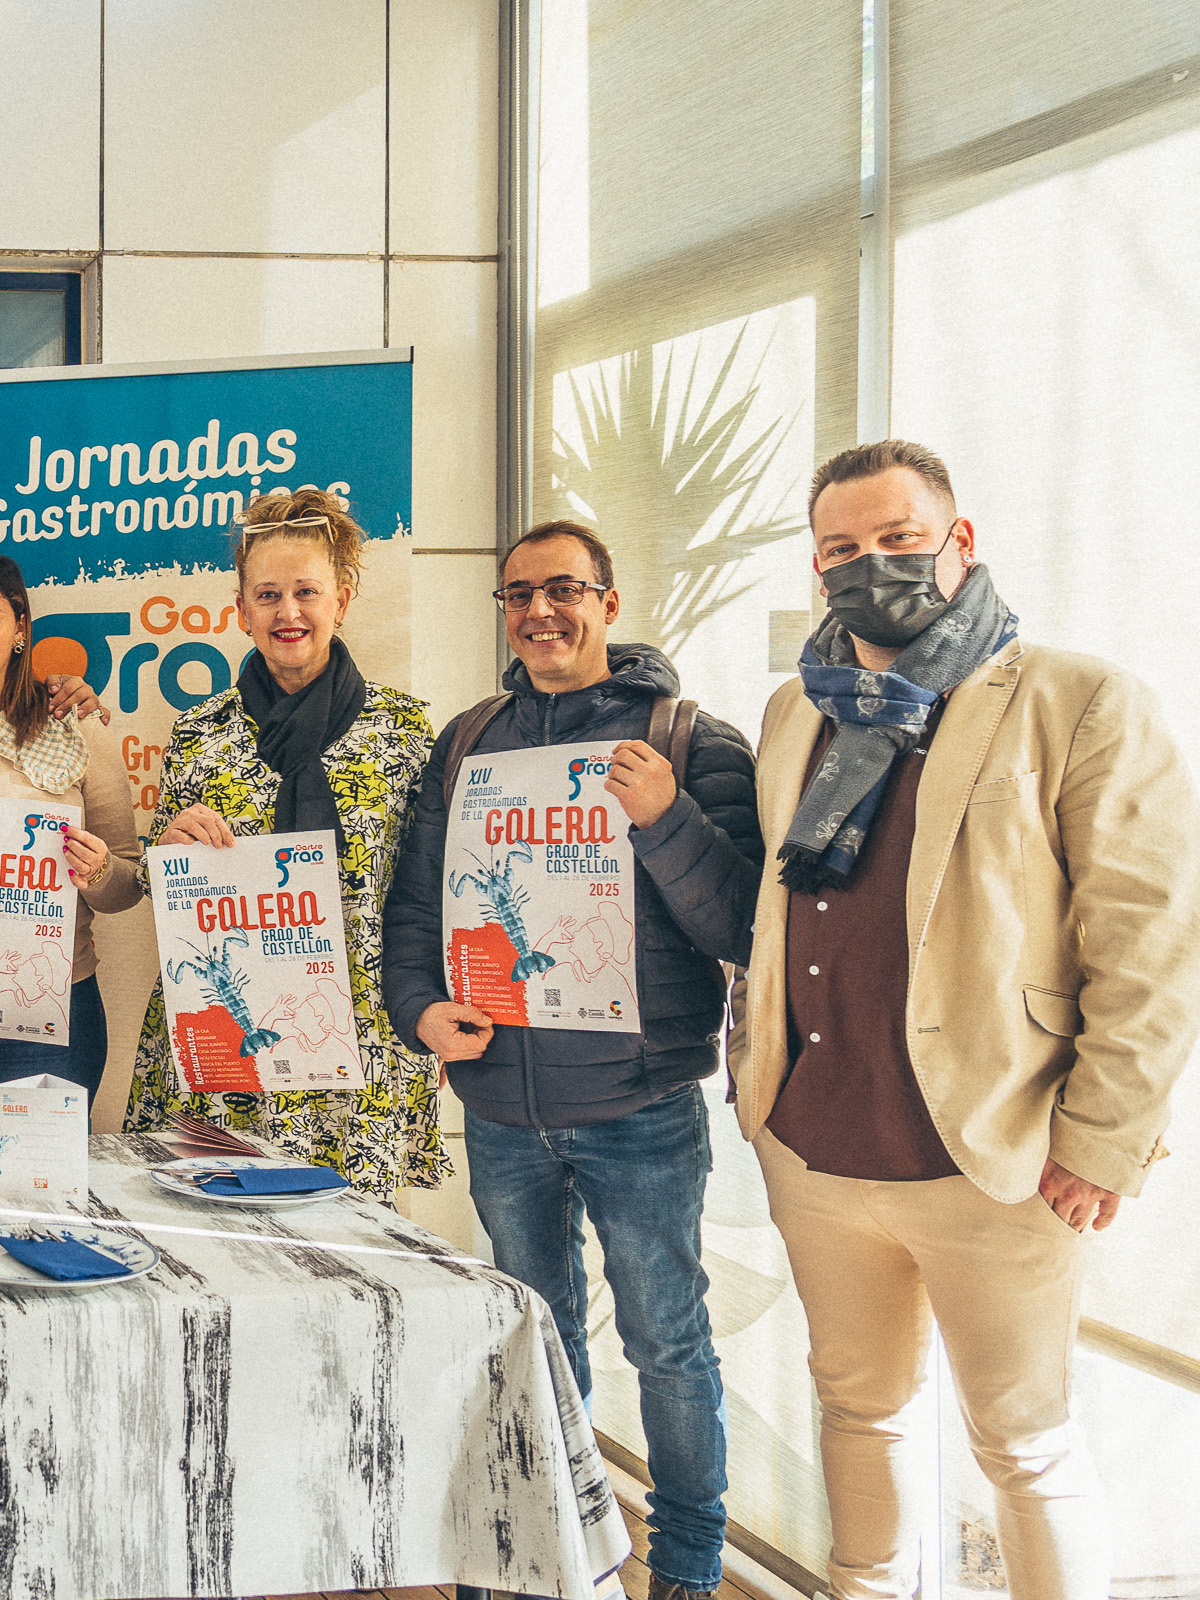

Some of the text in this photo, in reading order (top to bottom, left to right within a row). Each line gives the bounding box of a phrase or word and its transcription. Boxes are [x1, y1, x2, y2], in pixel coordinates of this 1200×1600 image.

[15, 418, 298, 495] Jornadas
[468, 767, 492, 785] XIV
[465, 786, 502, 798] JORNADAS
[463, 796, 527, 808] GASTRONÓMICAS
[462, 810, 482, 820] DE LA
[485, 806, 616, 844] GALERA
[546, 844, 600, 858] GRAO DE
[162, 858, 189, 876] XIV
[275, 848, 323, 888] grao
[546, 856, 620, 874] CASTELLÓN
[166, 876, 208, 888] JORNADAS
[589, 883, 620, 896] 2025
[0, 888, 48, 904] GRAO DE
[166, 886, 237, 900] GASTRONÓMICAS
[168, 900, 192, 910] DE LA
[196, 891, 326, 932] GALERA
[35, 924, 62, 938] 2025
[262, 927, 314, 942] GRAO DE
[262, 936, 334, 956] CASTELLÓN
[306, 962, 334, 974] 2025
[460, 944, 471, 1006] estaurantes
[186, 1027, 204, 1084] Restaurantes
